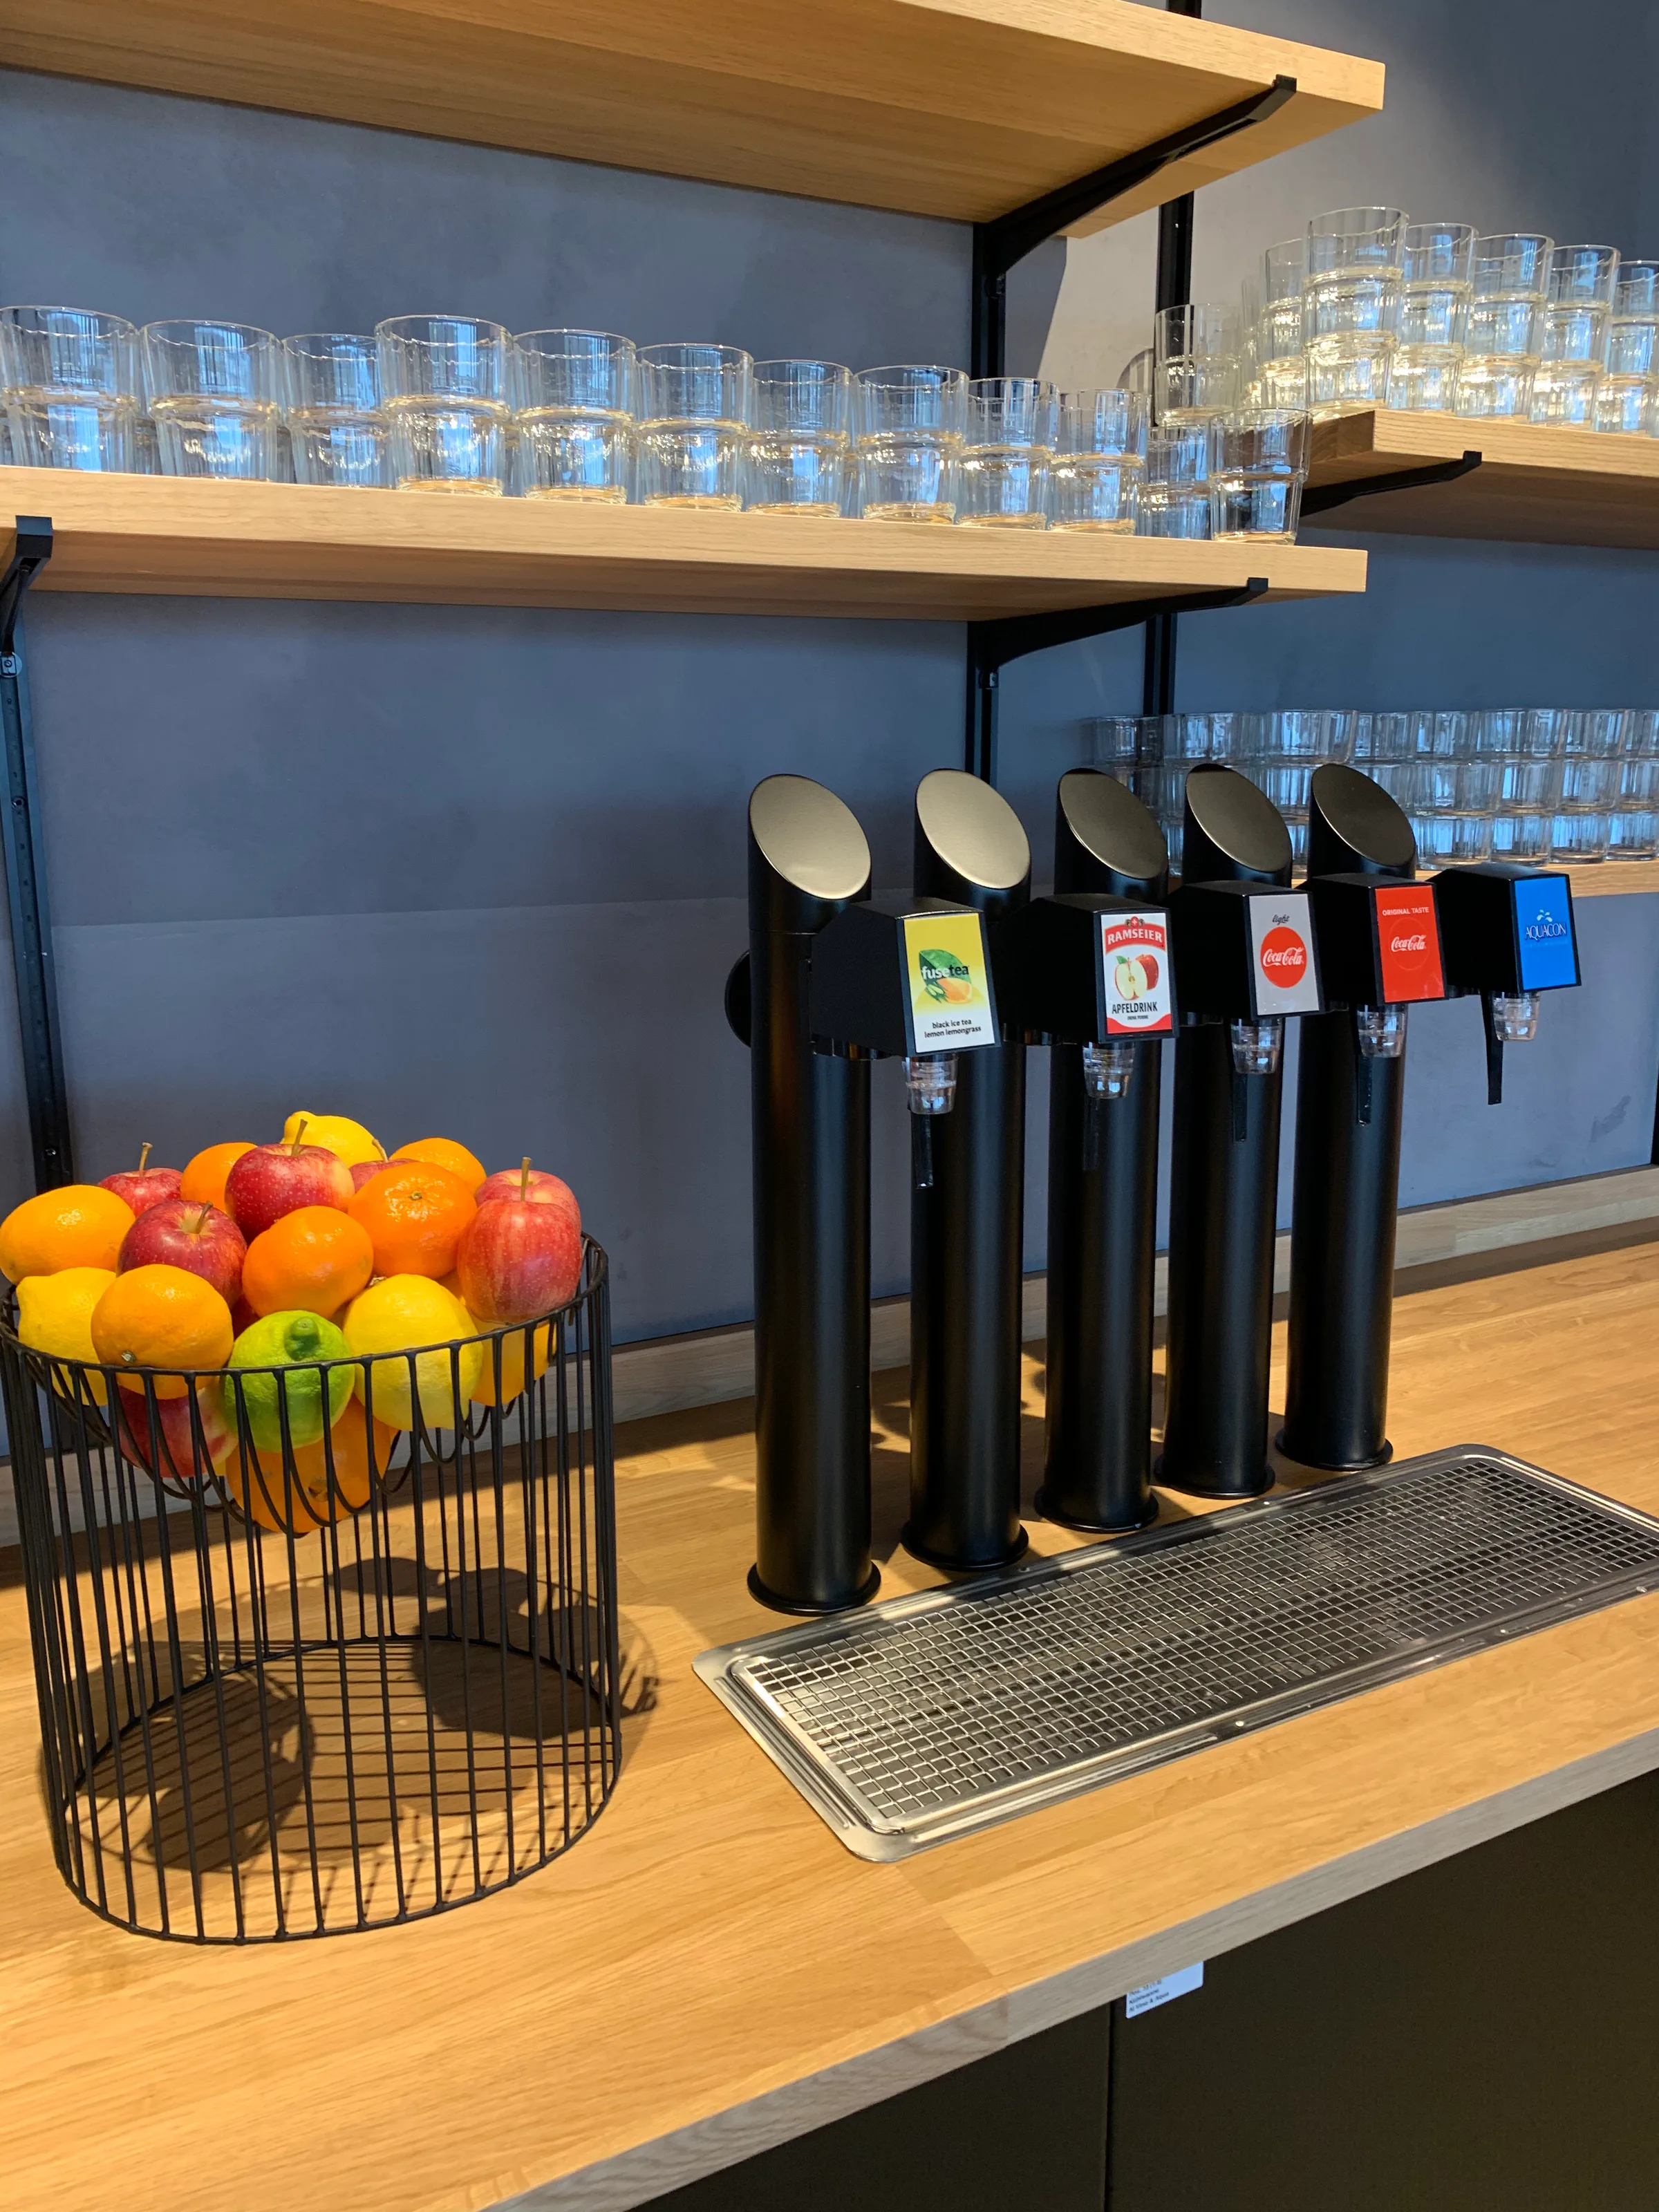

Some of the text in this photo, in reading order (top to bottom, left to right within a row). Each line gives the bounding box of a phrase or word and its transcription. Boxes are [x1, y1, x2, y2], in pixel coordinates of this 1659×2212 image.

[1272, 914, 1290, 925] light
[1107, 928, 1163, 945] RAMSEIER
[1525, 923, 1566, 941] AQUACON
[1112, 1002, 1158, 1014] APFELDRINK
[932, 1020, 950, 1029] black
[946, 1026, 982, 1035] lemongrass
